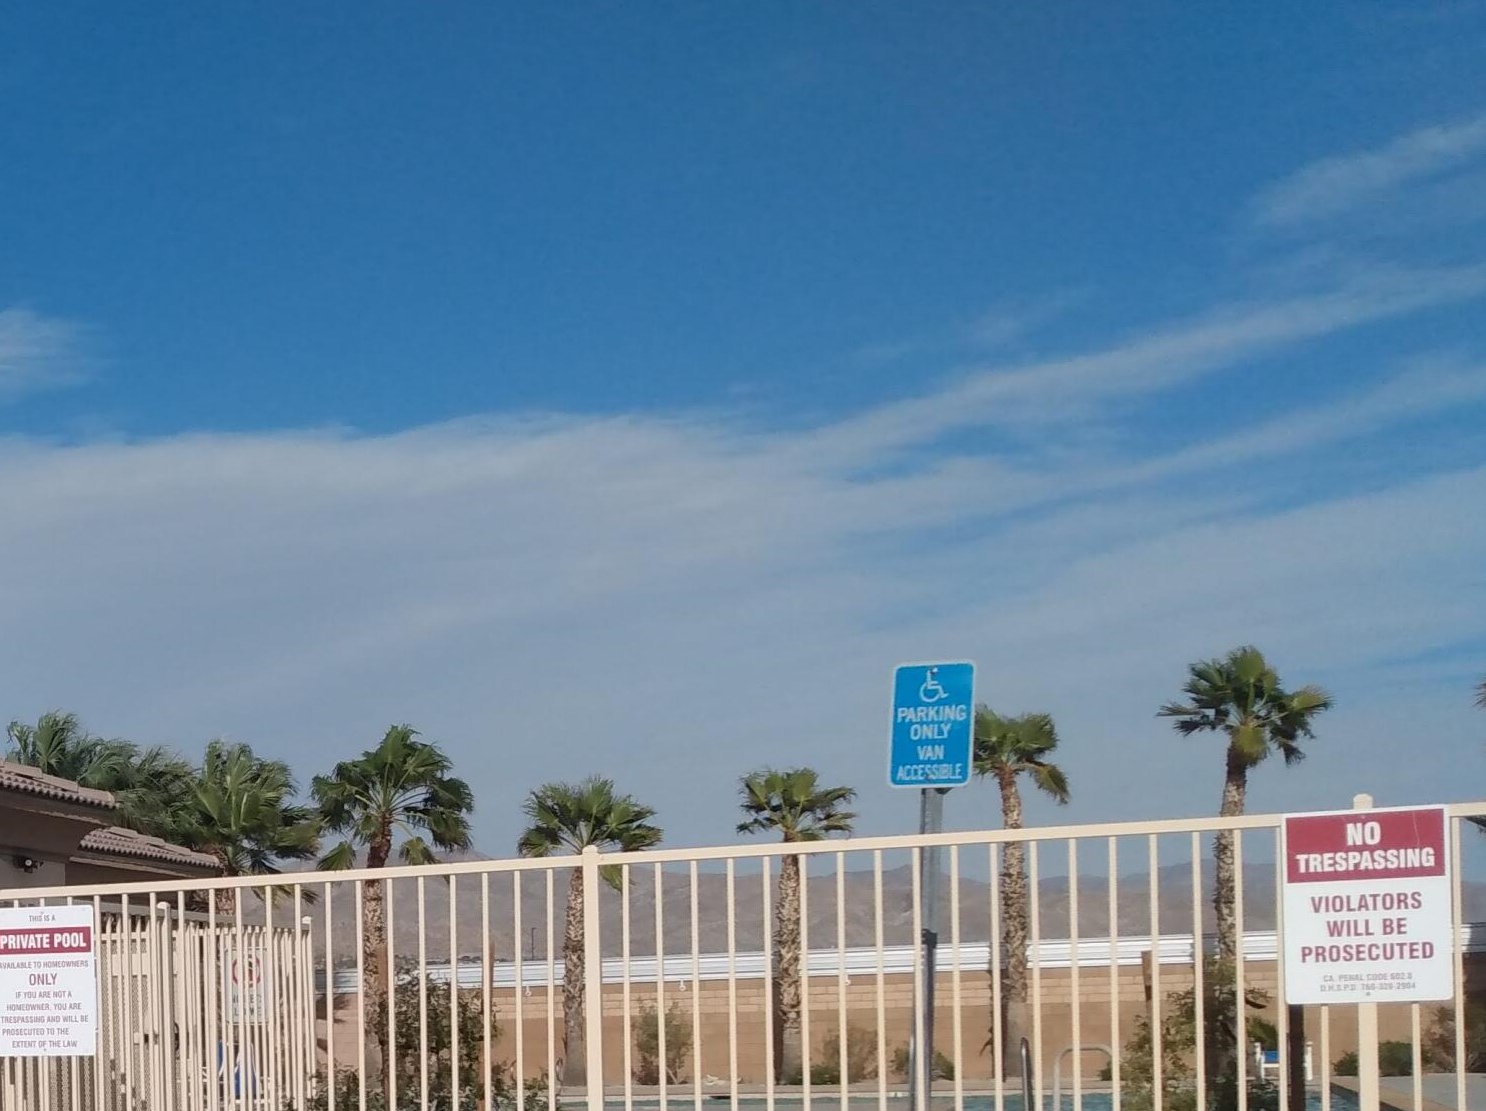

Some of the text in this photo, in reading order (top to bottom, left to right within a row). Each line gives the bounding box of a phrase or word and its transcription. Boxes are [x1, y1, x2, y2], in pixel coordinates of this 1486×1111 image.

[897, 704, 967, 723] PARKING
[910, 722, 952, 740] ONLY
[917, 744, 945, 761] VAN
[896, 763, 963, 781] ACCESSIBLE
[1346, 821, 1381, 846] NO
[1296, 847, 1435, 873] TRESPASSING
[1311, 891, 1422, 914] VIOLATORS
[1326, 917, 1408, 938] WILL BE
[0, 932, 87, 950] PRIVATE POOL
[1301, 941, 1435, 963] PROSECUTED
[33, 961, 42, 969] TO
[43, 960, 89, 968] HOMEOWNERS
[29, 972, 58, 986] ONLY
[15, 991, 22, 999] IF
[24, 991, 37, 999] YOU
[68, 1002, 82, 1010] ARE
[1, 1014, 89, 1024] TRESPASSING AND WILL BE
[2, 1028, 45, 1036] PROSECUTED
[57, 1027, 70, 1035] THE
[12, 1040, 78, 1048] EXTENT OF THE LAW
